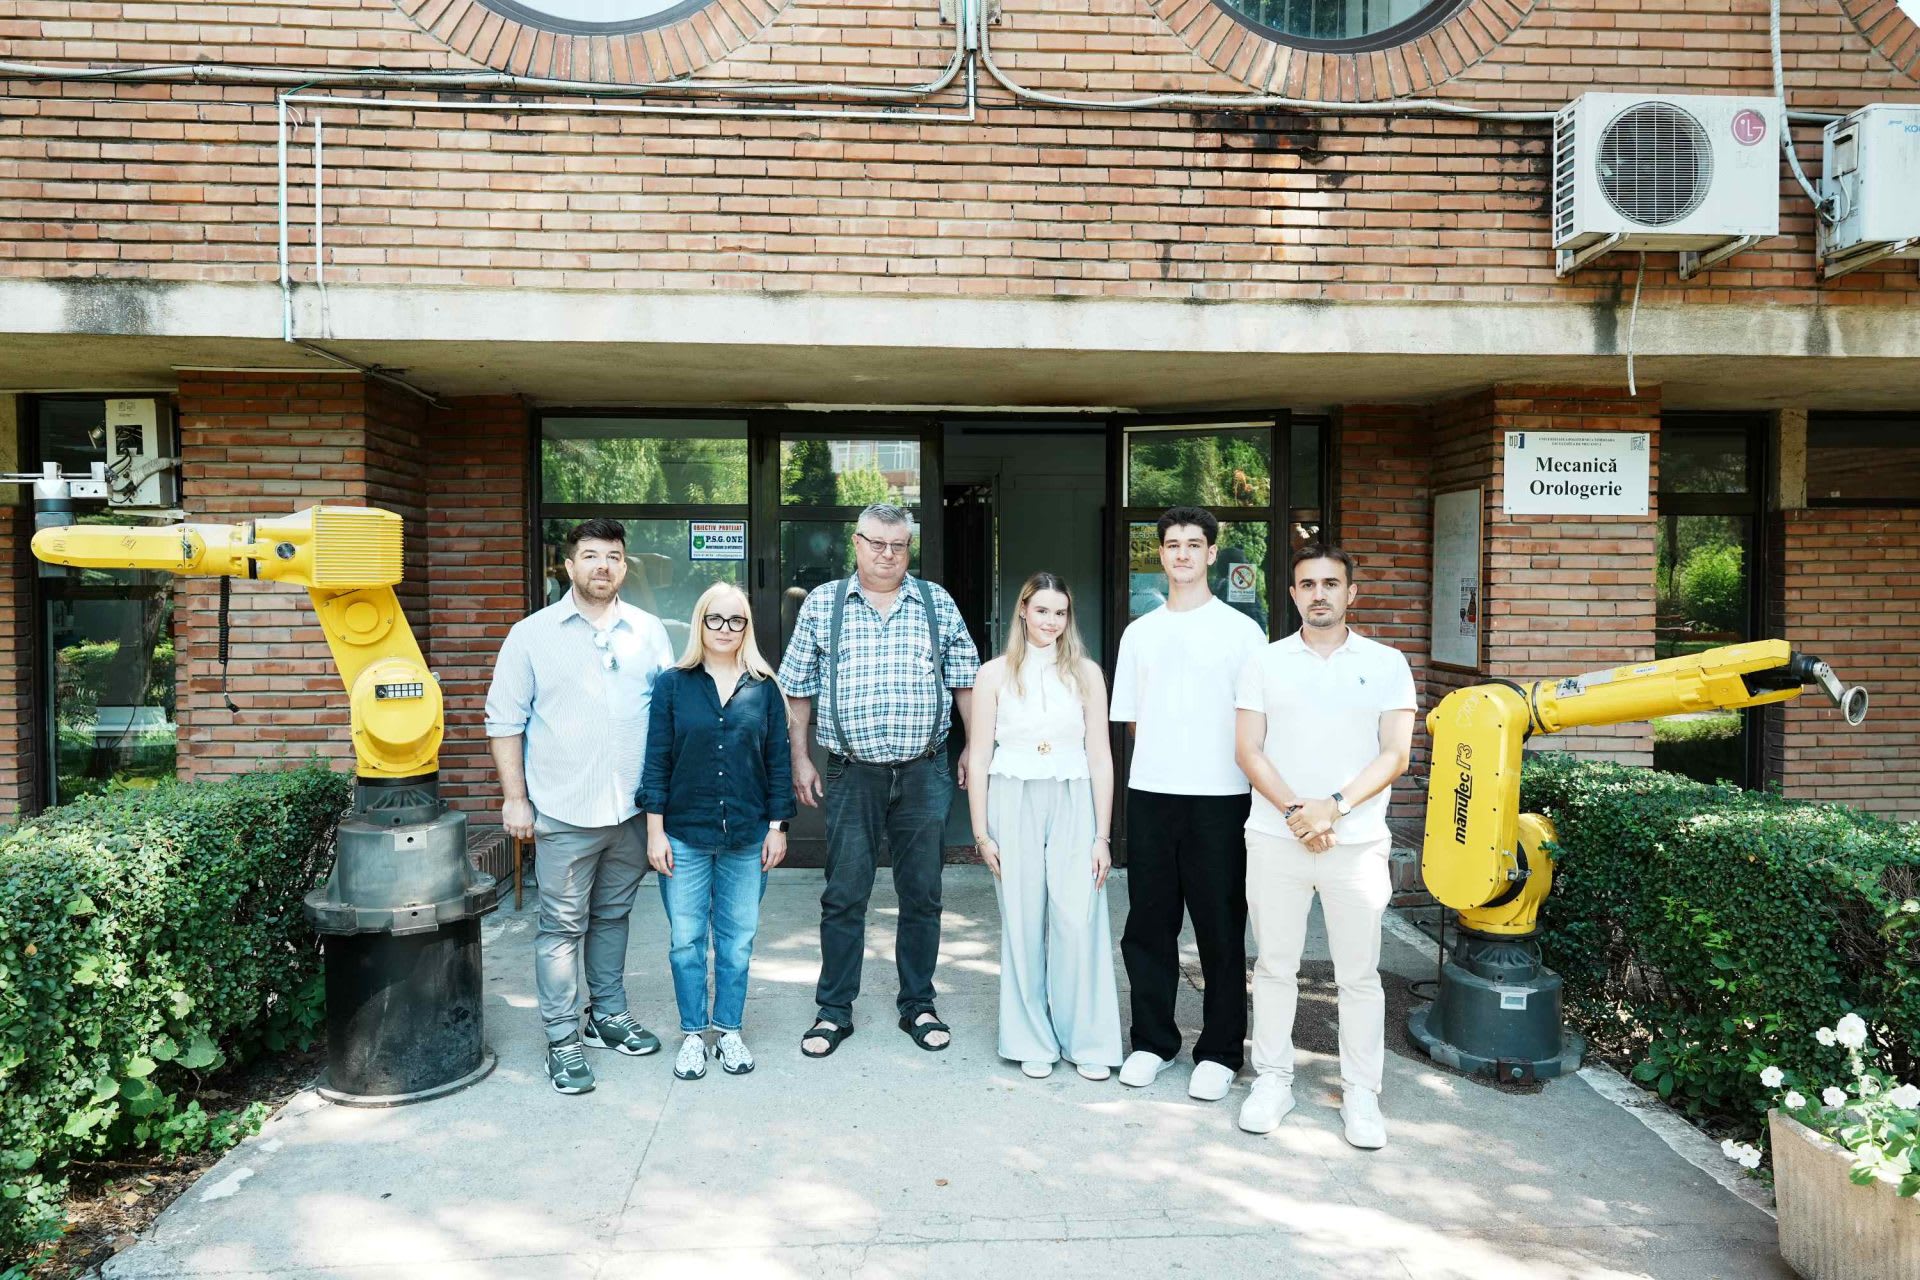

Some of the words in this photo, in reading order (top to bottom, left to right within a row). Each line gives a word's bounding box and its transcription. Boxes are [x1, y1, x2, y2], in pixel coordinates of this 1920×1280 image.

[1732, 110, 1765, 145] LG
[1535, 456, 1617, 473] Mecanică
[1529, 479, 1622, 500] Orologerie
[726, 535, 743, 543] ONE
[1456, 743, 1473, 771] r3
[1454, 772, 1473, 845] manutec
